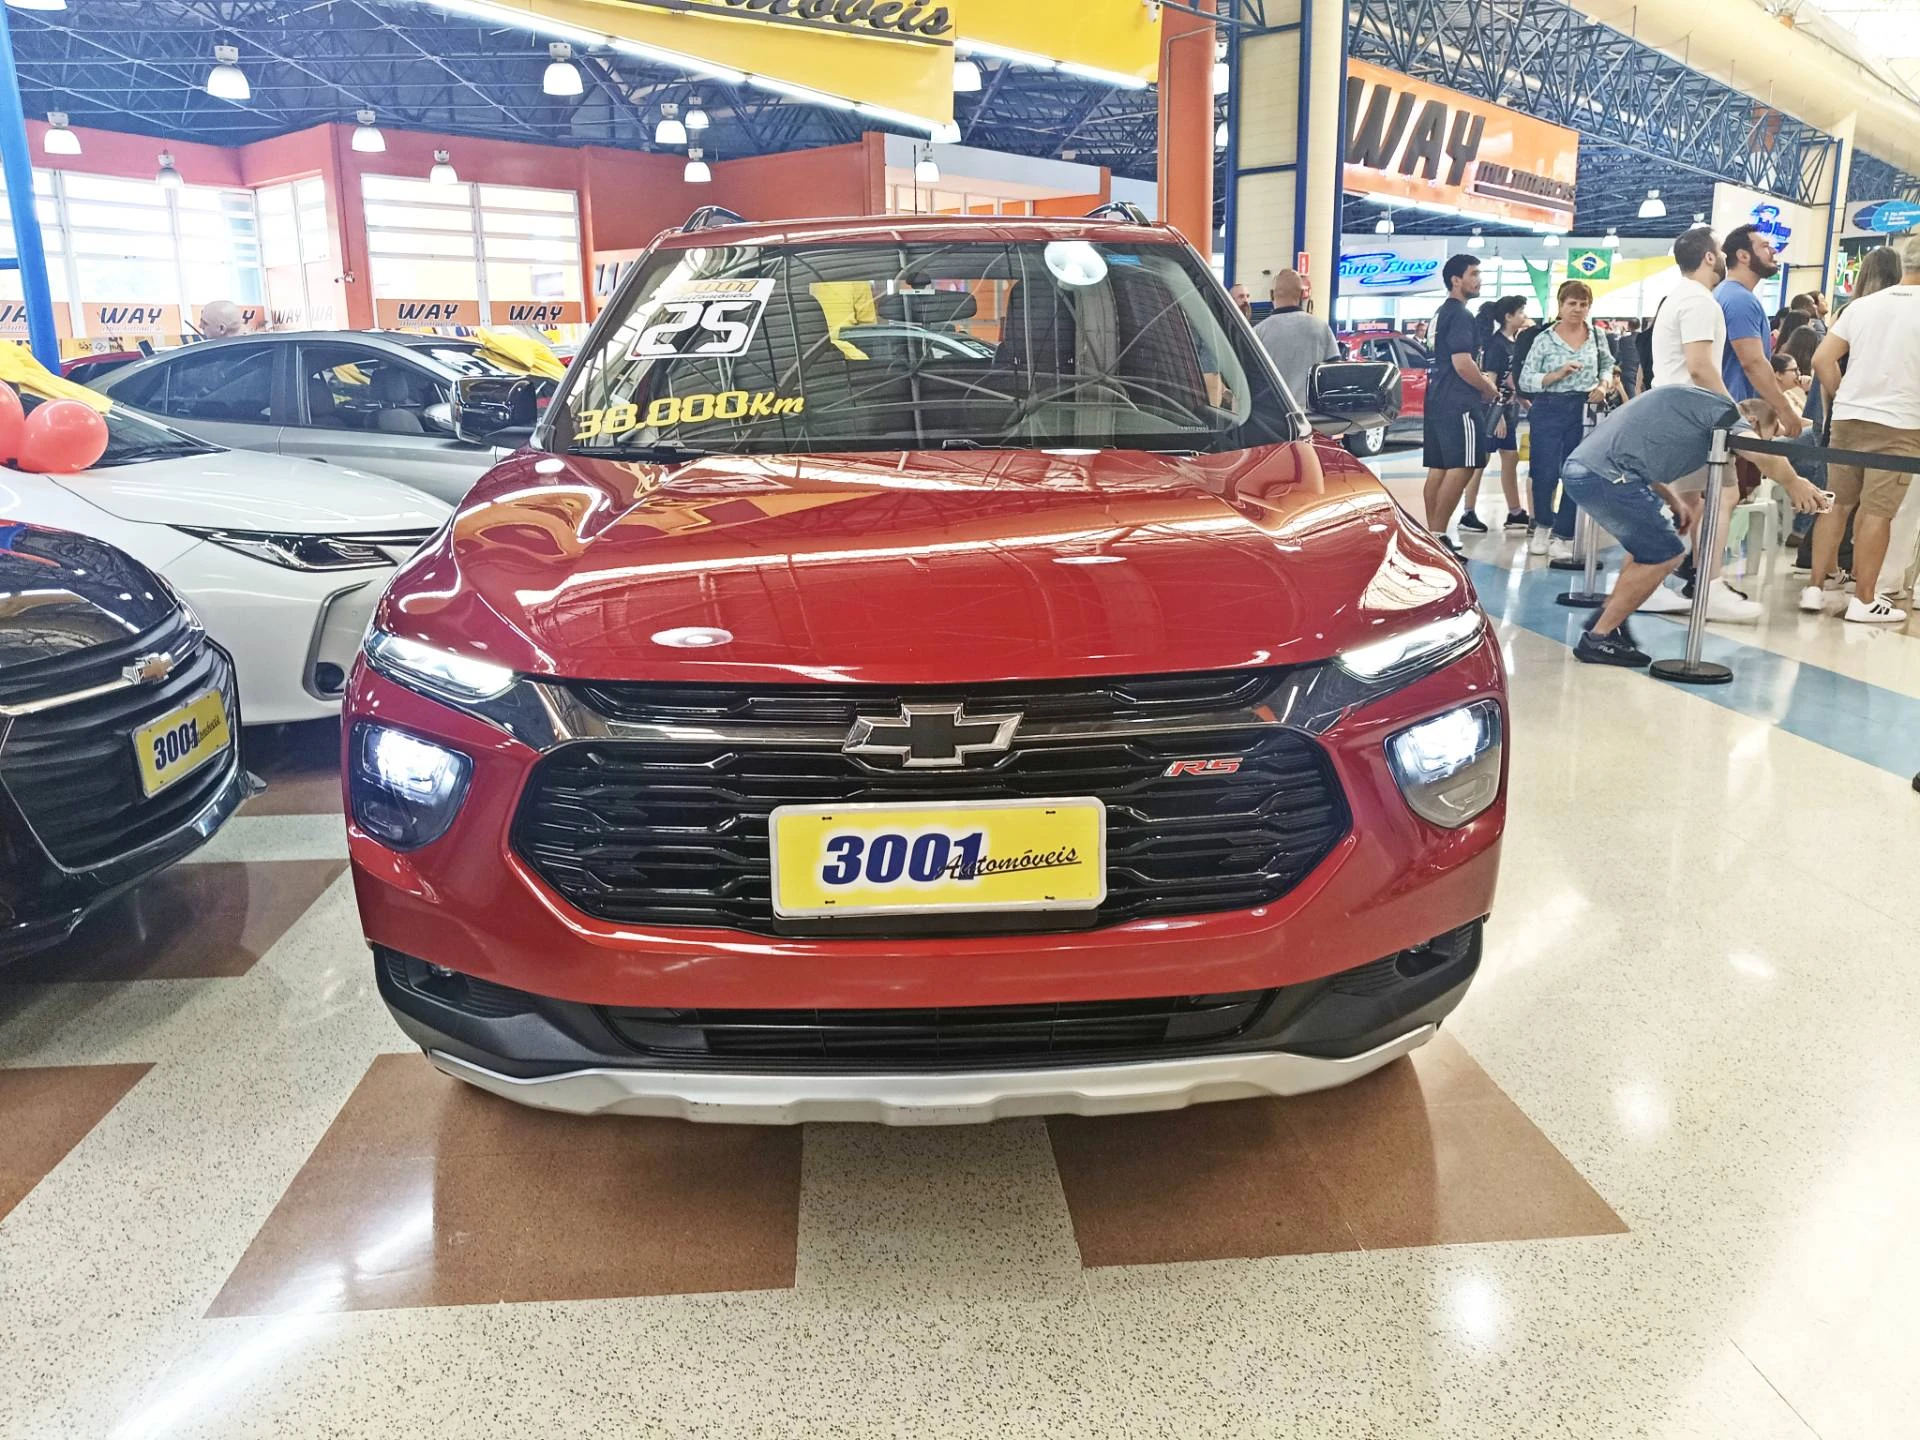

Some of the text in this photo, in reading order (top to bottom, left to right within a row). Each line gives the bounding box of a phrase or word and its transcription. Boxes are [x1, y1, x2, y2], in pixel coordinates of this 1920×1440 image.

[1345, 76, 1486, 186] WAY
[1339, 258, 1439, 277] Auto Fluxo
[100, 307, 162, 324] WAY
[273, 308, 301, 325] WAY
[399, 303, 458, 320] WAY
[509, 305, 563, 321] WAY
[634, 301, 755, 354] 25
[153, 717, 198, 771] 3001
[1162, 757, 1244, 777] RS
[822, 832, 983, 885] 3001
[933, 845, 1081, 881] Automóveis
